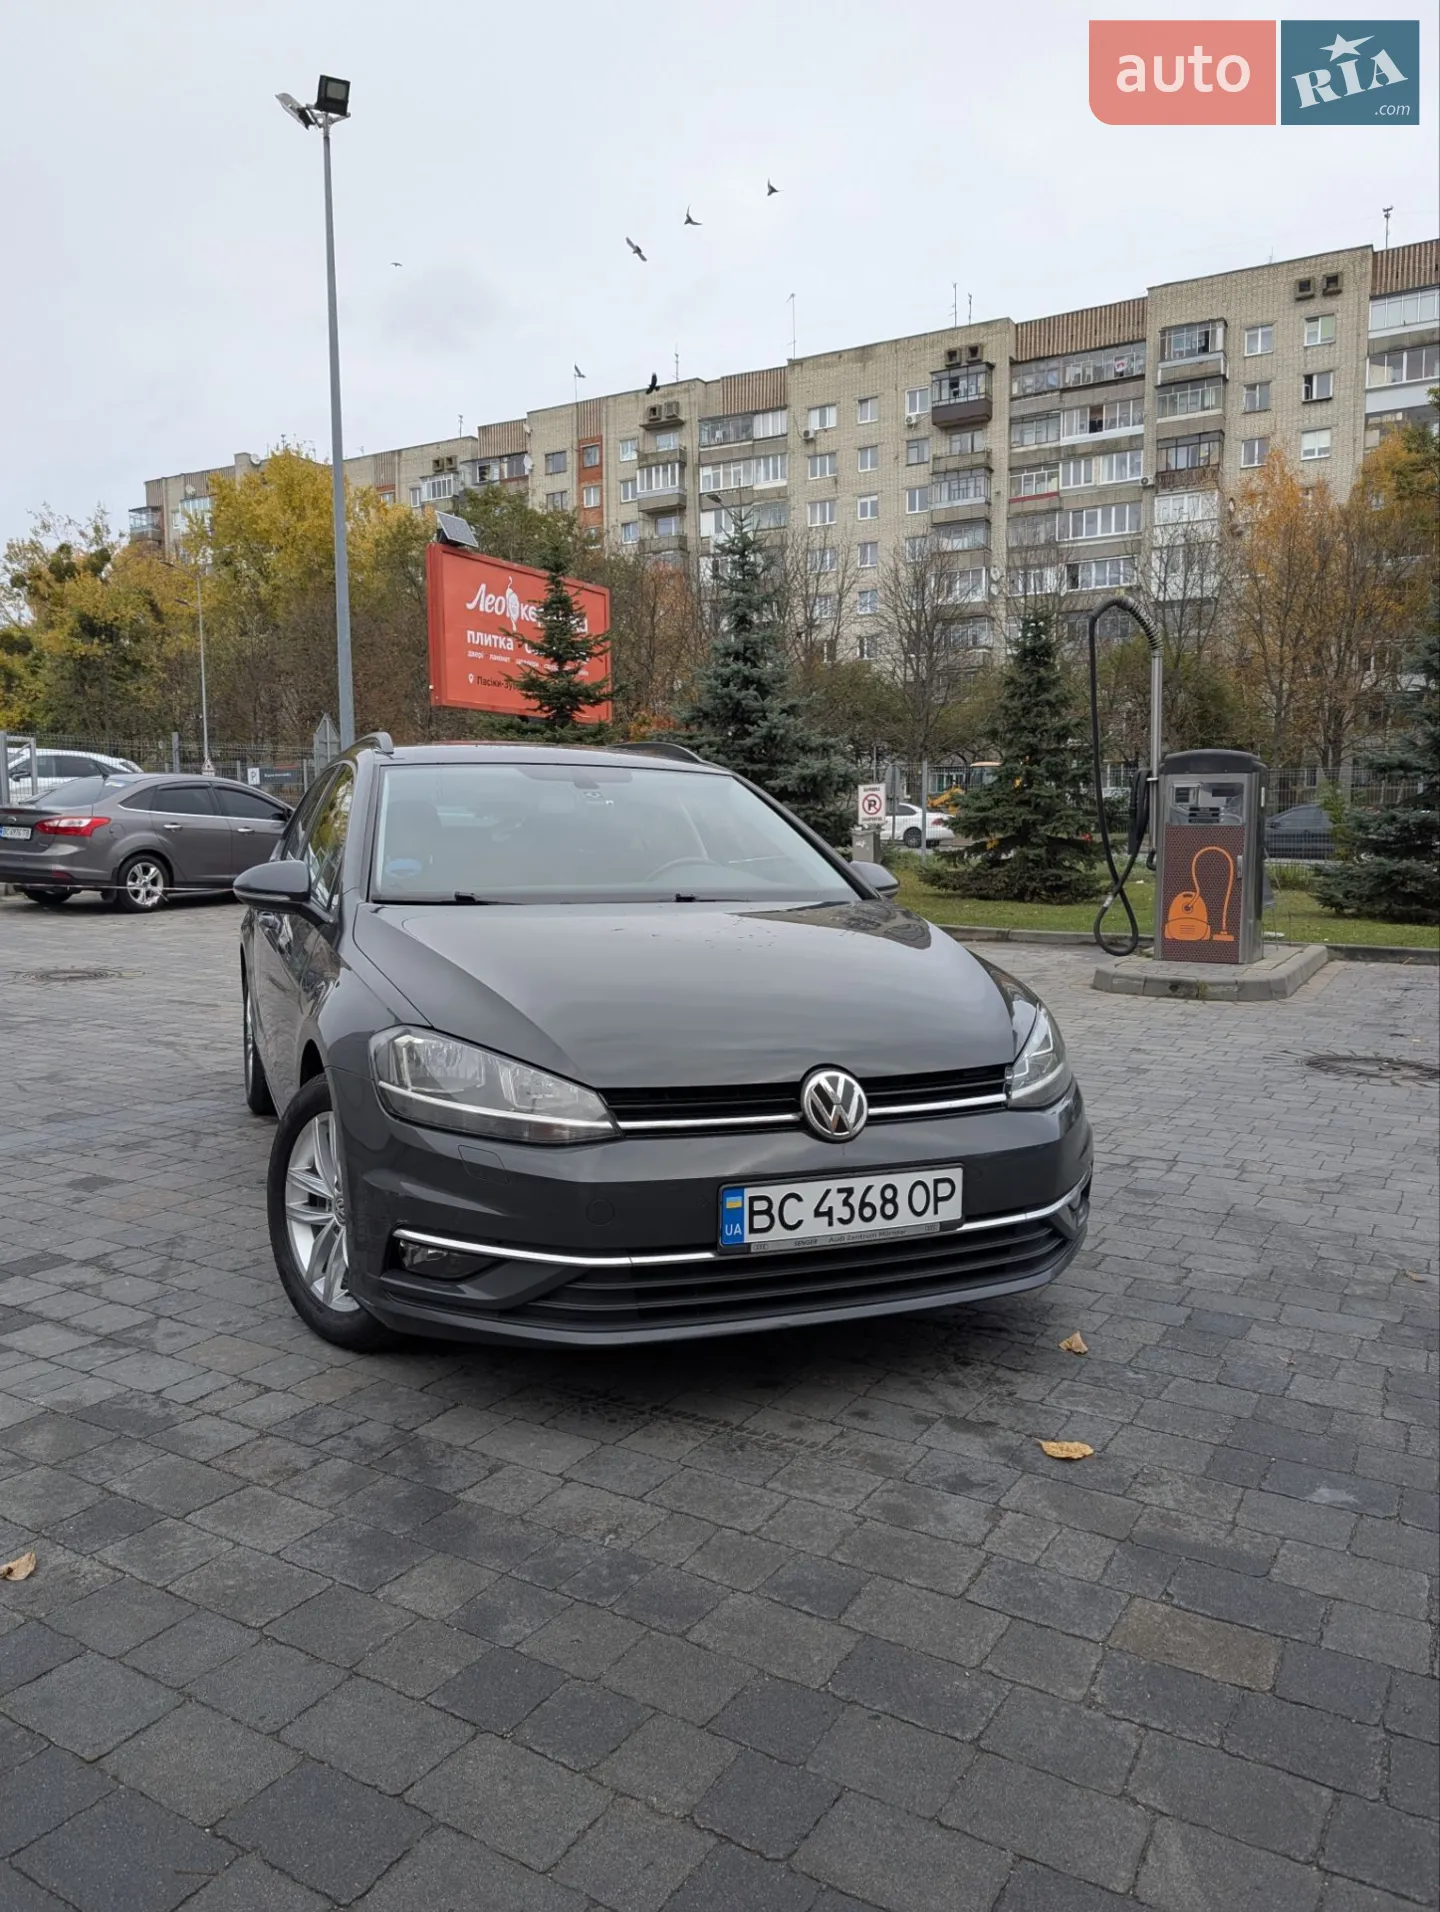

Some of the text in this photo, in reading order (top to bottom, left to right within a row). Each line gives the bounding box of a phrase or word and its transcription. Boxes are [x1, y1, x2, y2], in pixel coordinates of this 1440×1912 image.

[466, 630, 514, 651] плитка
[477, 675, 518, 691] Пасіки-Зу
[748, 1176, 956, 1235] BC 4368 OP
[725, 1223, 742, 1236] UA
[828, 1235, 845, 1243] Audi
[846, 1232, 877, 1242] Zentrum
